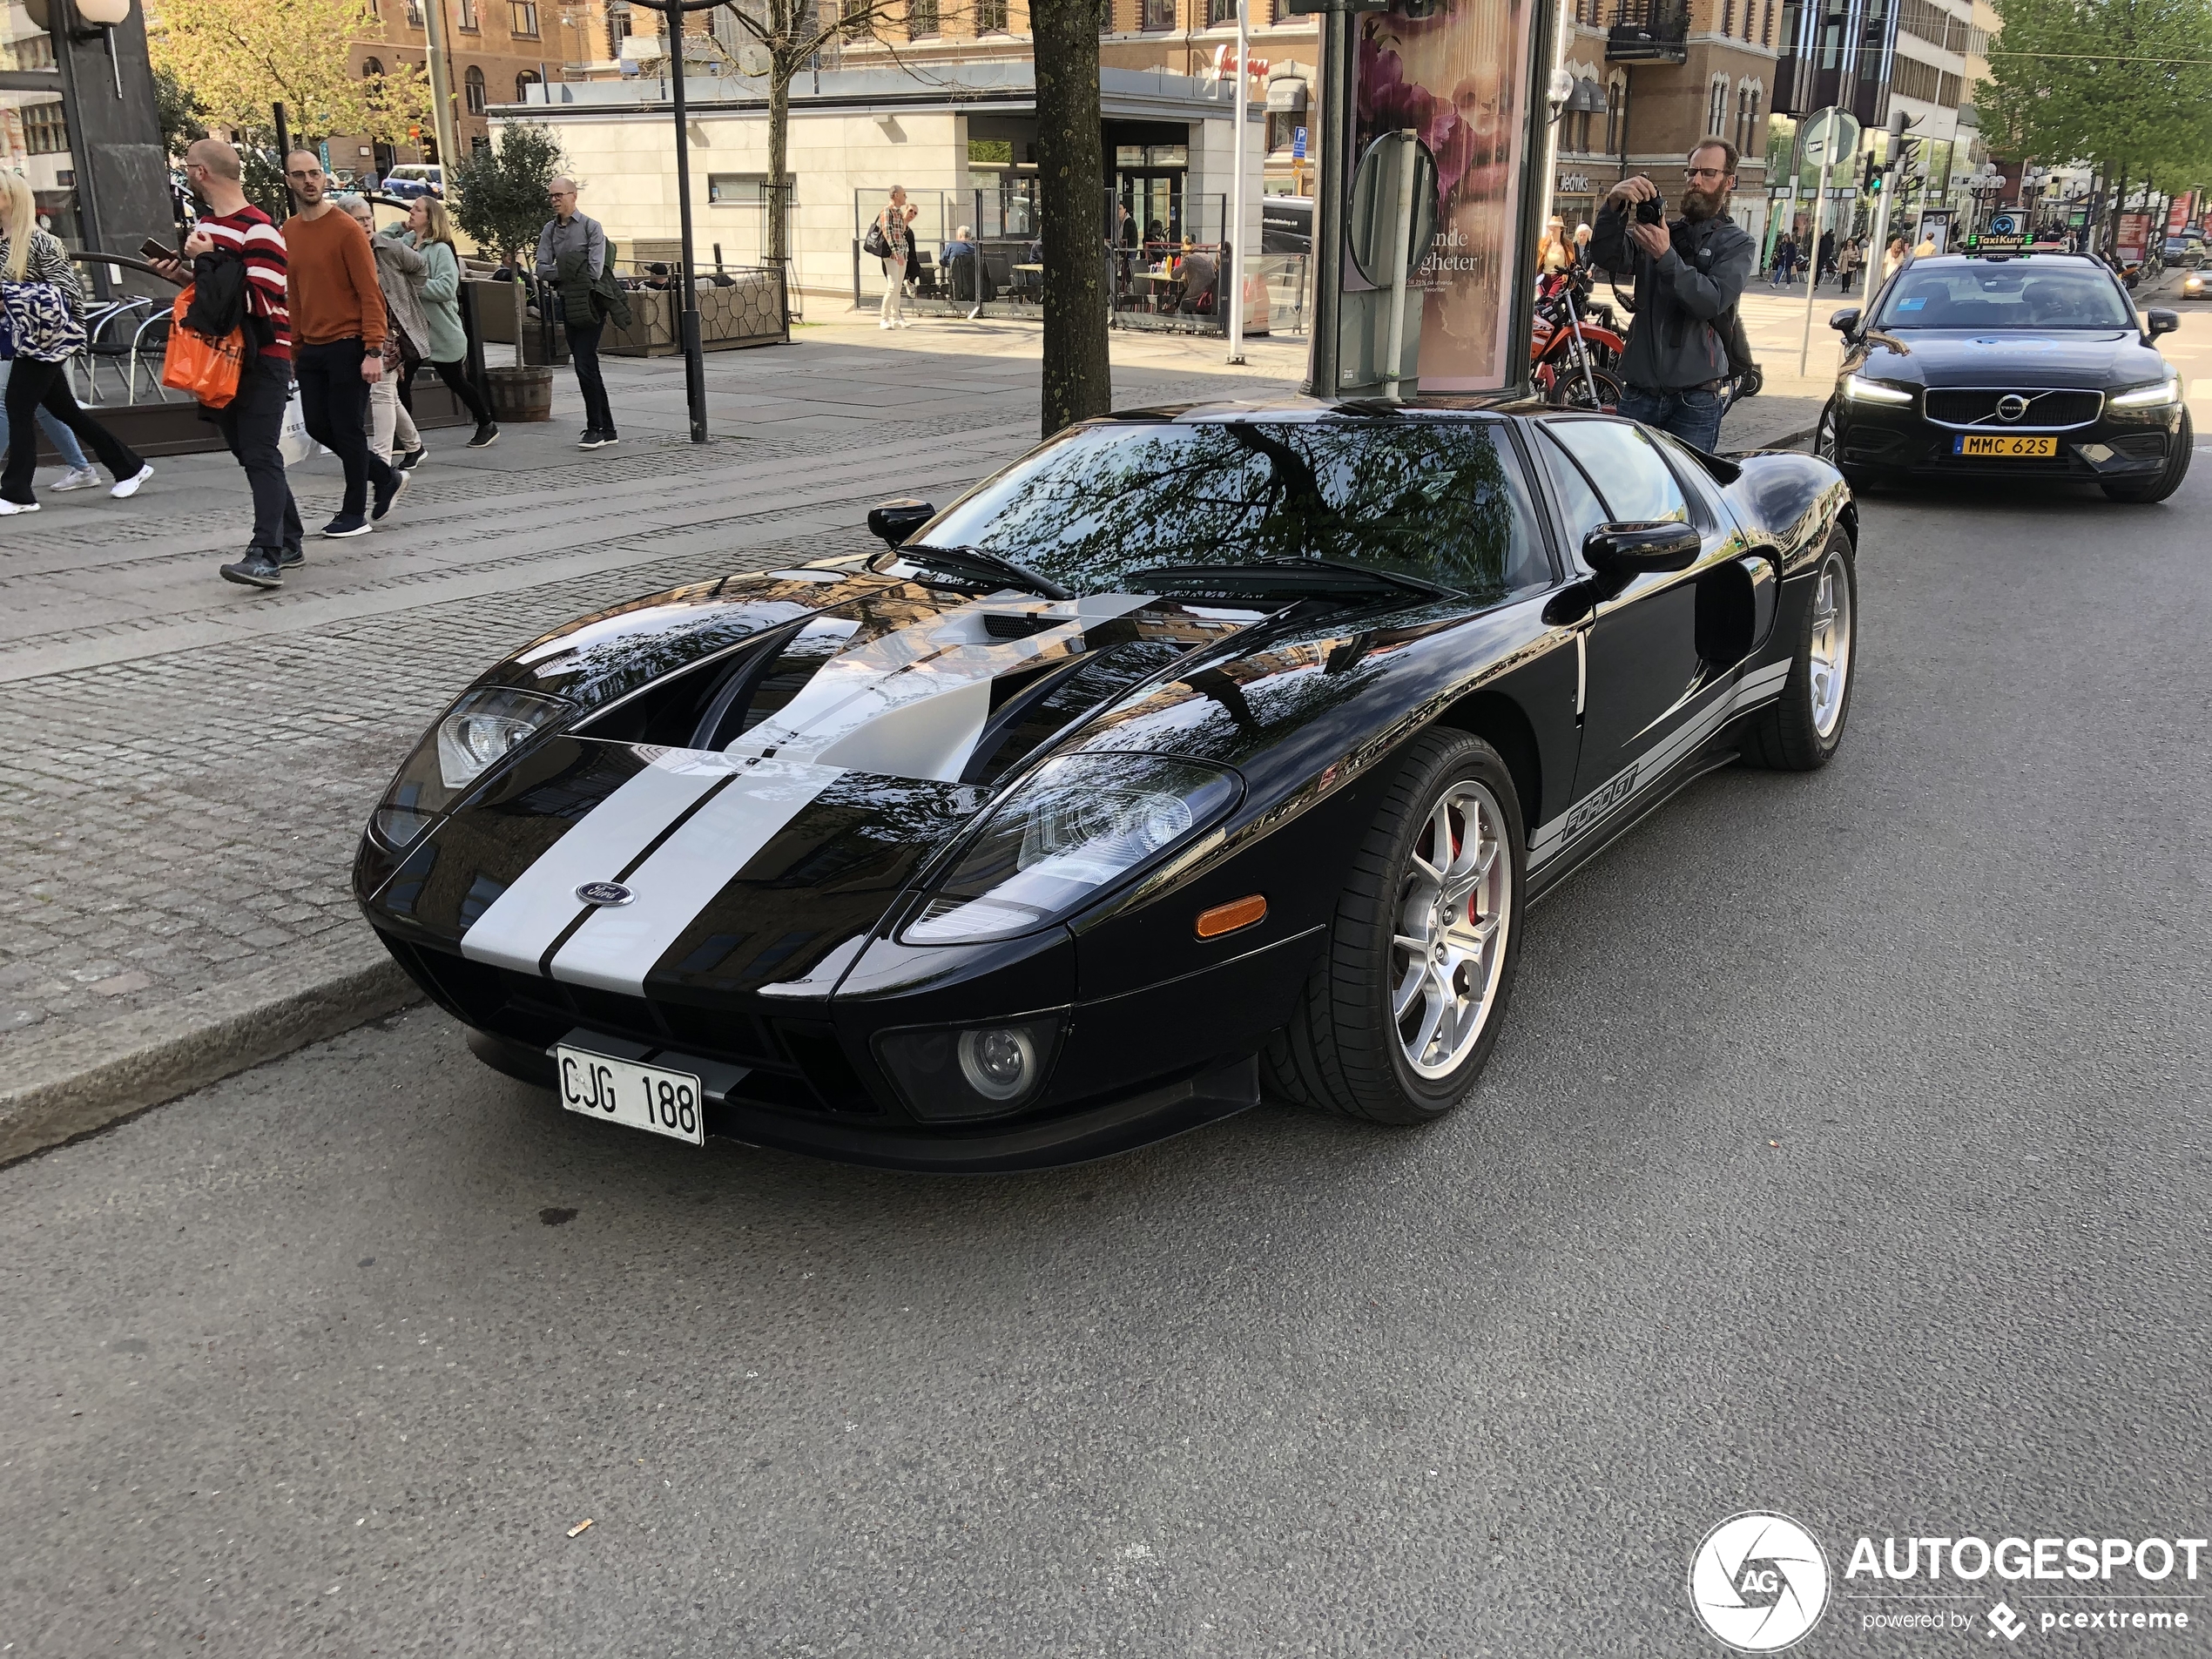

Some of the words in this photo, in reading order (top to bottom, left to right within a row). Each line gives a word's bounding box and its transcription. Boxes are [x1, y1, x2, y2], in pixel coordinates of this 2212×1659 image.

[1298, 129, 1305, 140] P
[1560, 172, 1588, 192] Jedviks
[1432, 228, 1468, 246] nde
[1419, 253, 1478, 276] gheter
[1968, 438, 2006, 454] MMC
[2012, 439, 2049, 455] 62S
[1611, 766, 1638, 802] GT
[587, 884, 621, 899] Ford
[562, 1056, 617, 1113] CJG
[642, 1076, 696, 1134] 188
